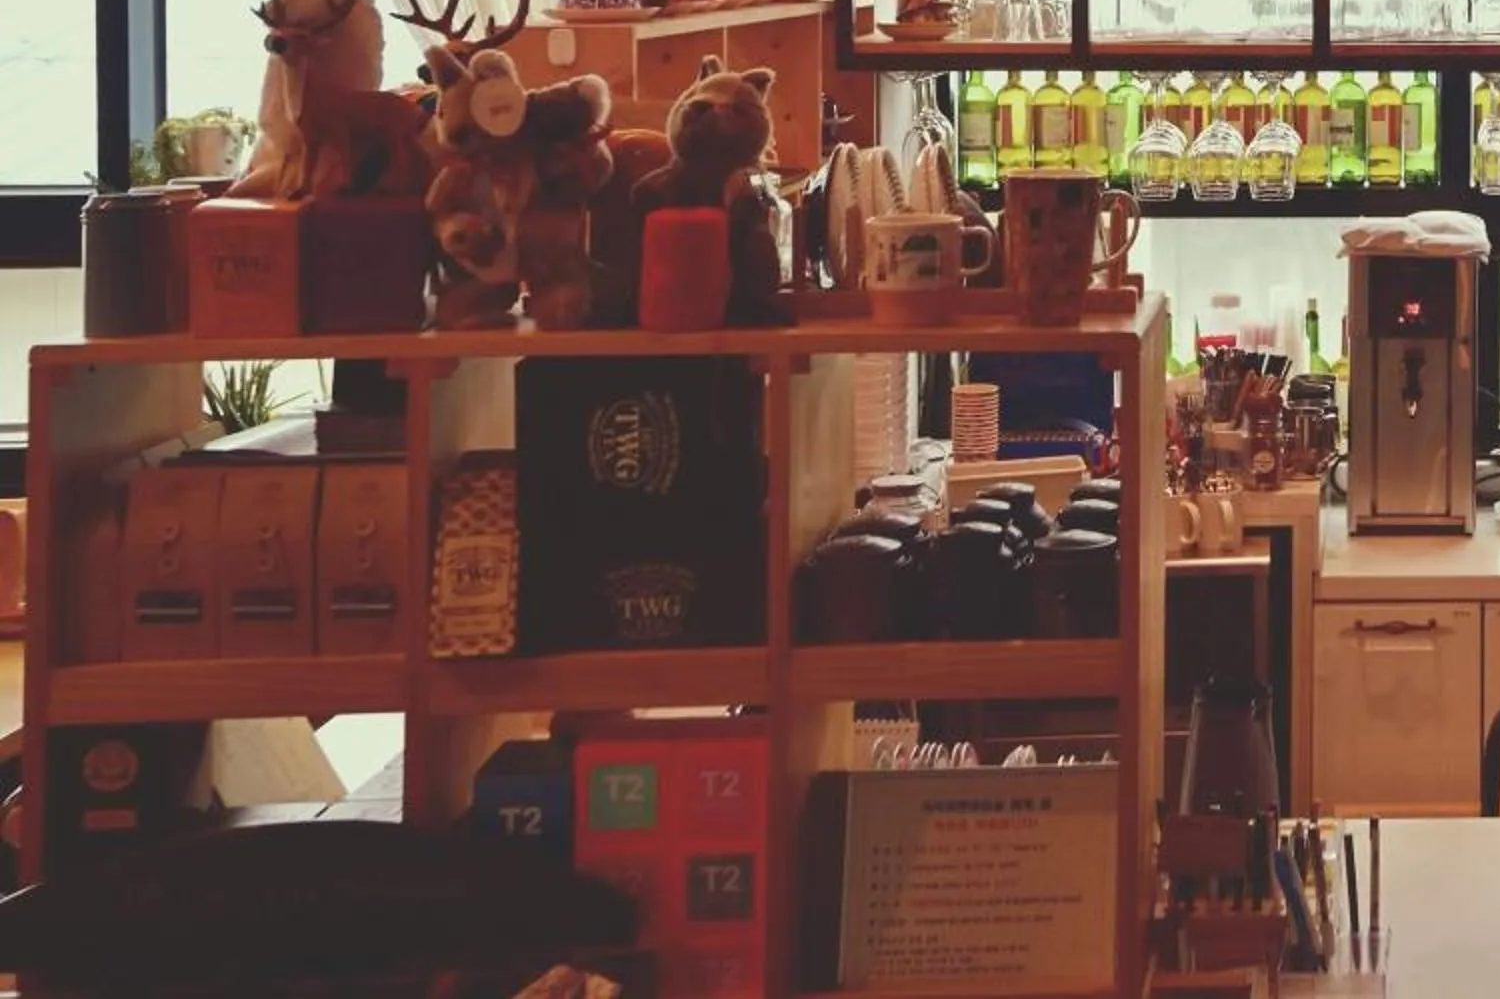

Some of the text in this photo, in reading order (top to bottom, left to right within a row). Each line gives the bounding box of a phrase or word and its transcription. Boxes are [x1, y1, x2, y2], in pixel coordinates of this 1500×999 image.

[615, 405, 640, 479] TWG
[617, 598, 682, 619] TWG
[603, 774, 646, 802] T2
[701, 771, 741, 798] T2
[498, 806, 544, 837] T2
[700, 865, 743, 893] T2
